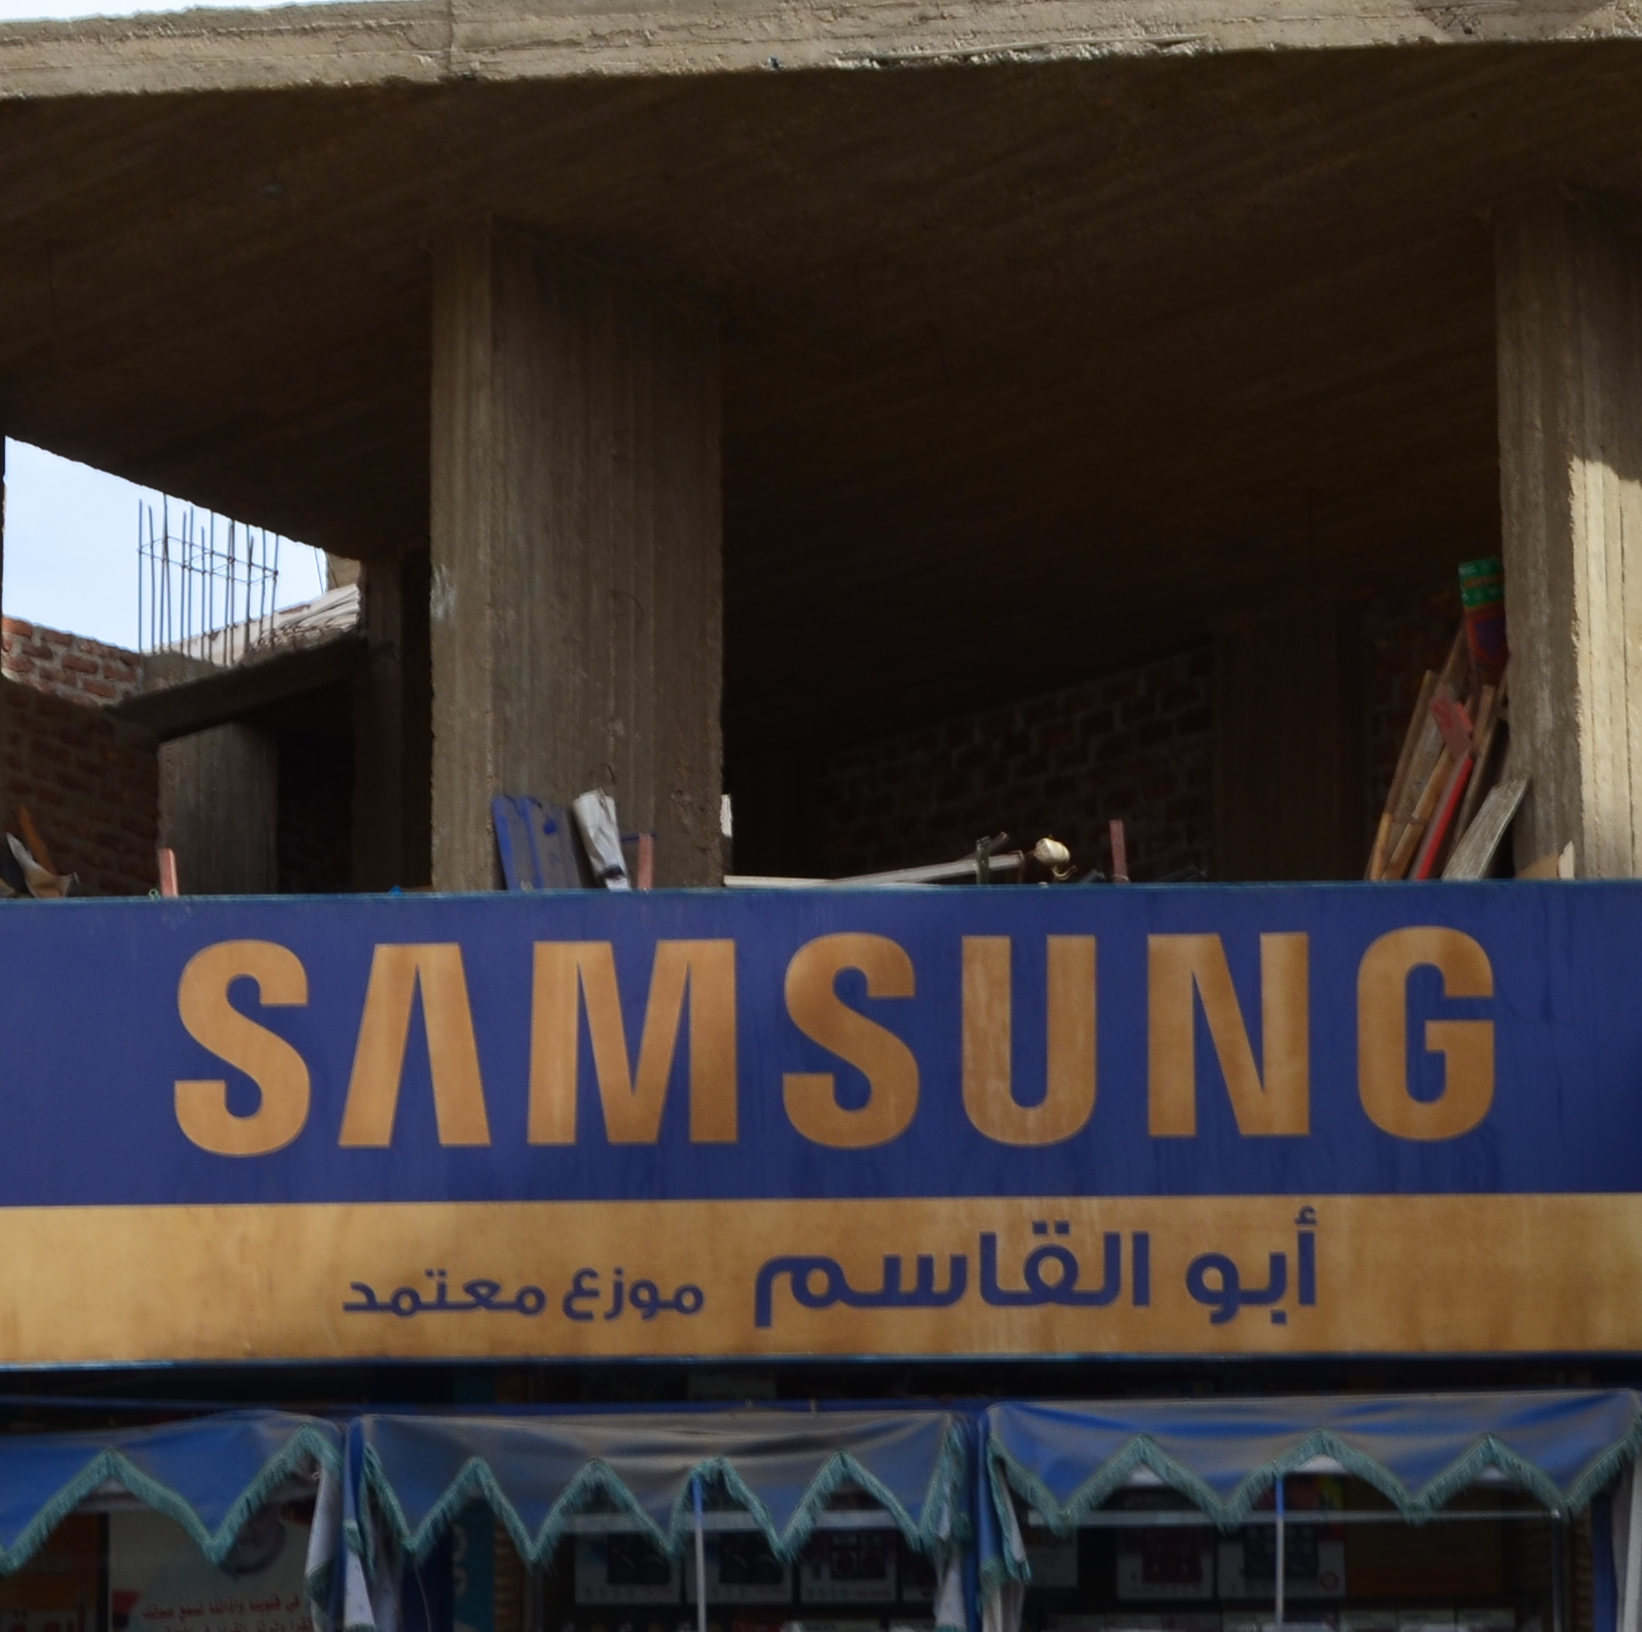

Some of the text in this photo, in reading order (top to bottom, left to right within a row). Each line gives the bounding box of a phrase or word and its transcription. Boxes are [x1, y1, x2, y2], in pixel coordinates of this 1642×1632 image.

[174, 925, 1496, 1157] SAMSUNG
[342, 1206, 1319, 1328] أبو القاسم موزع معتمد
